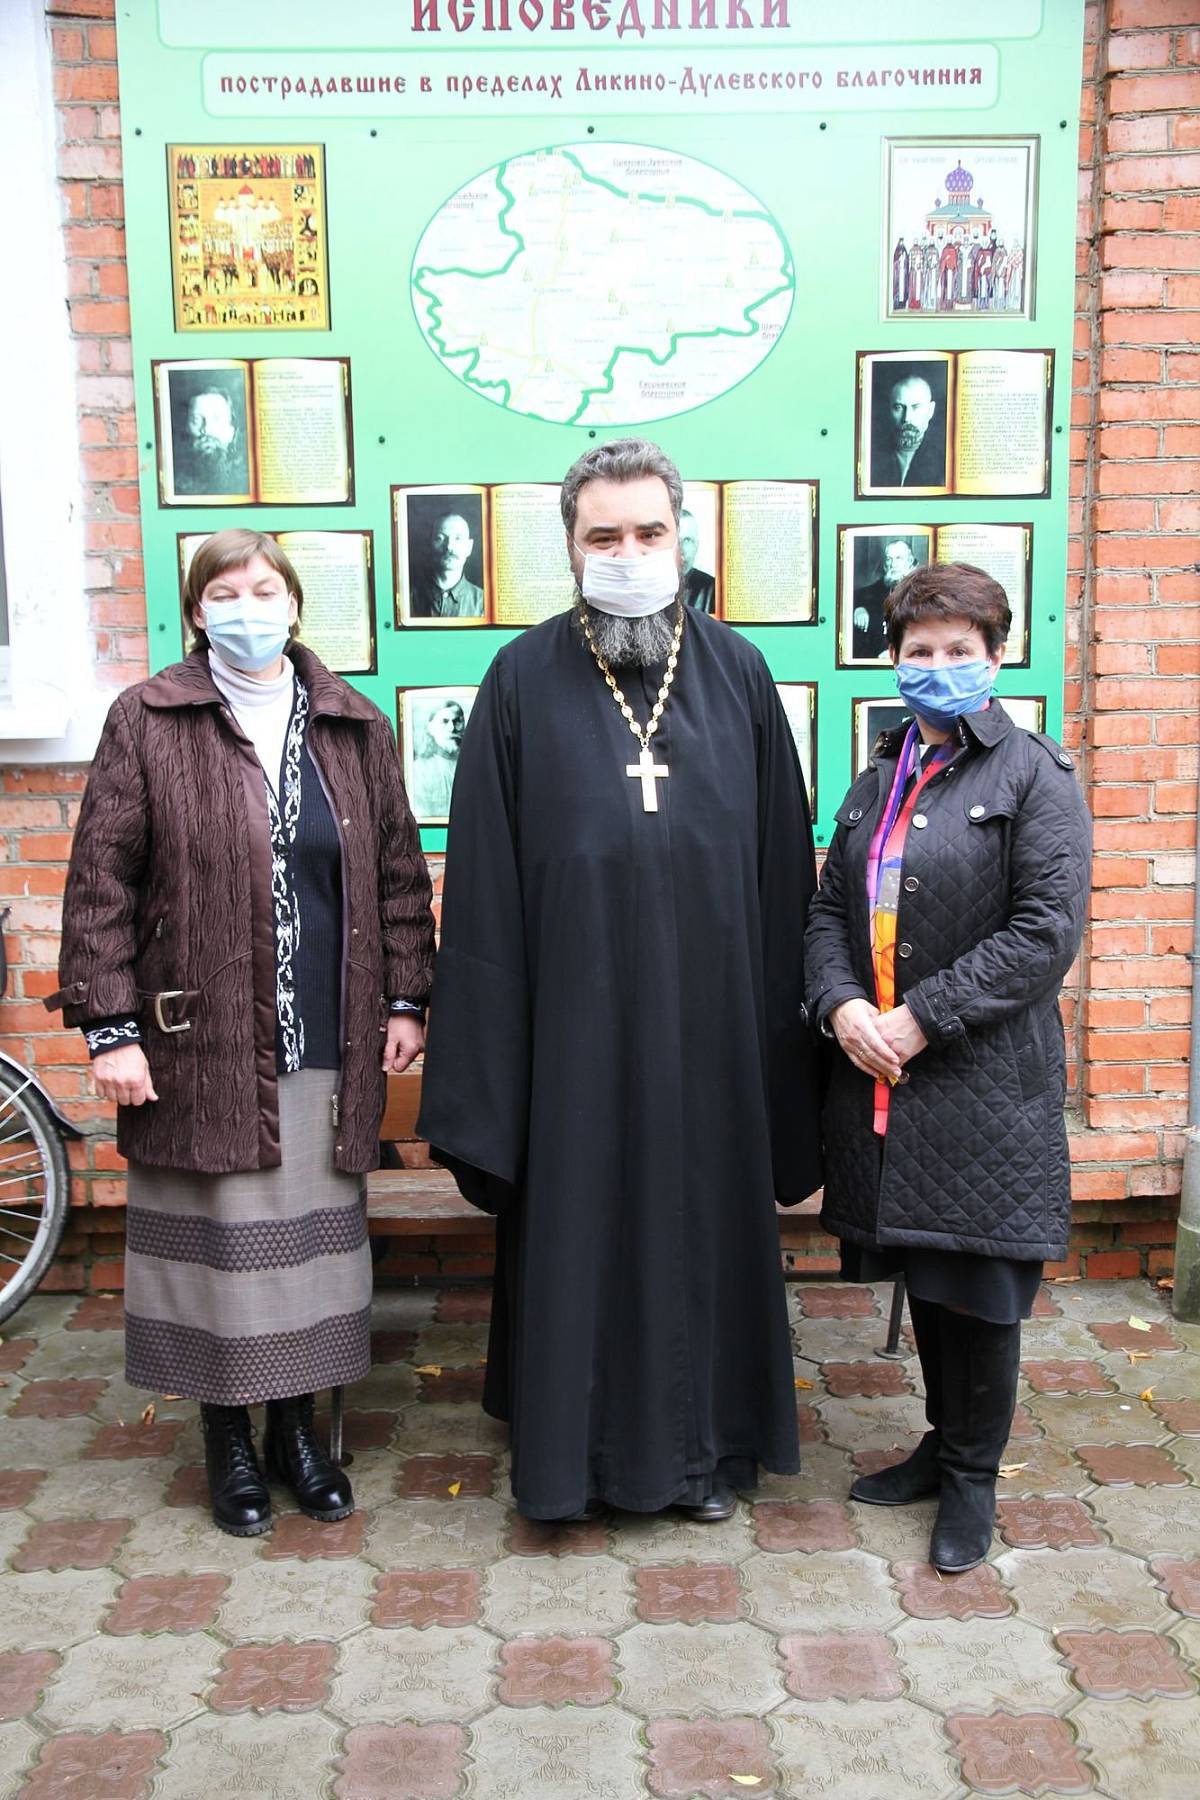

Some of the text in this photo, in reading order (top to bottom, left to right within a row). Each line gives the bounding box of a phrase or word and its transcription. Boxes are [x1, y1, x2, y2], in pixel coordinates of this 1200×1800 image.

[411, 0, 791, 39] ИСПОВЕДНИКИ
[220, 67, 983, 100] пострадавшие в пределах Ликино-Дулевского благочиния
